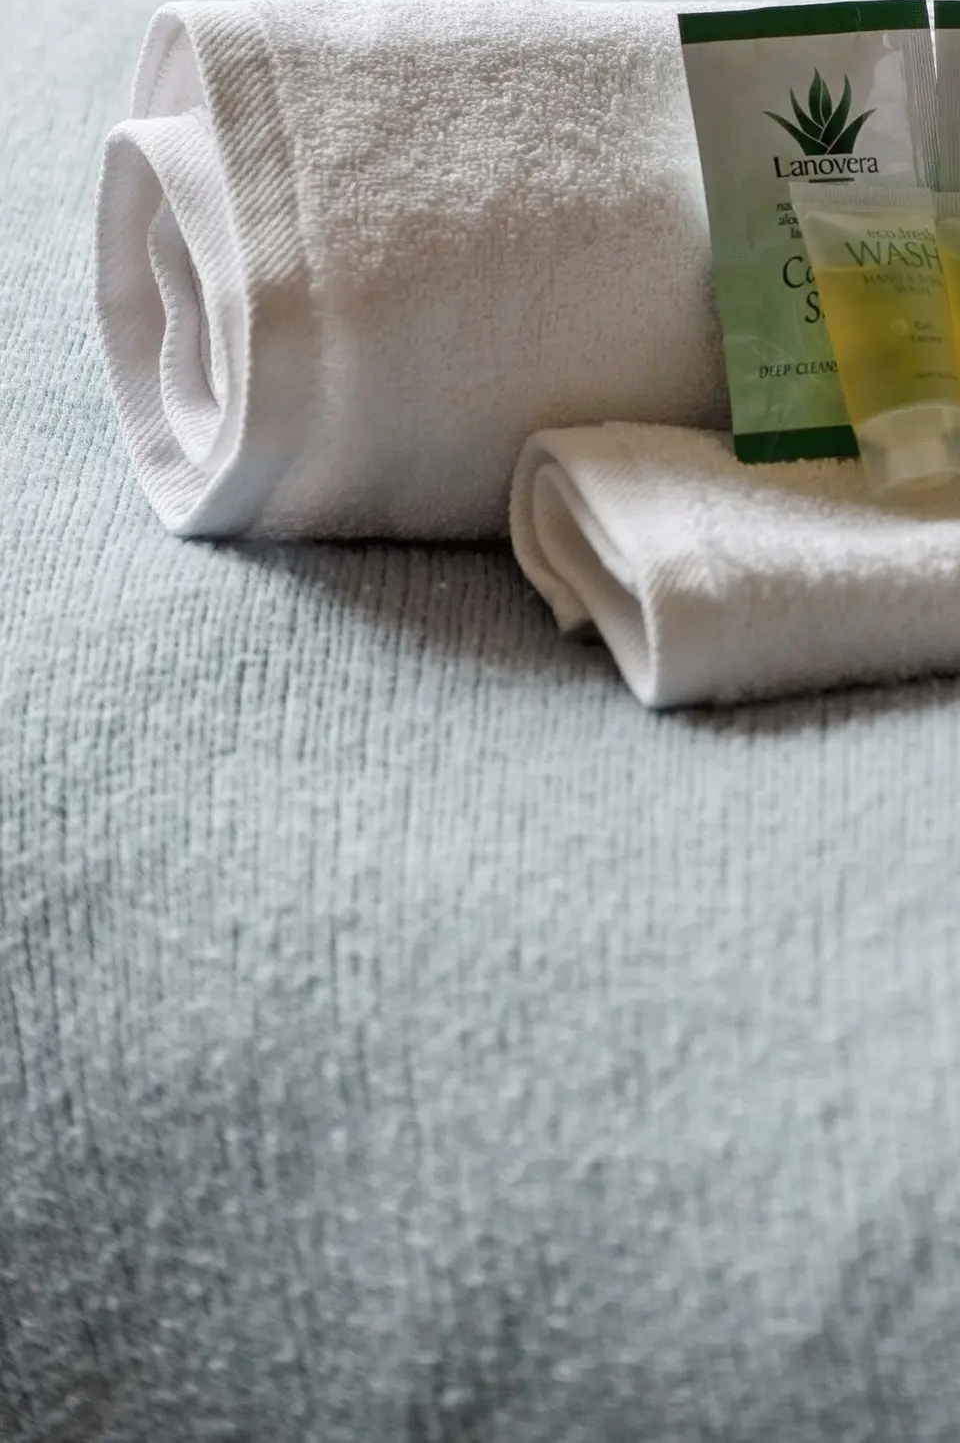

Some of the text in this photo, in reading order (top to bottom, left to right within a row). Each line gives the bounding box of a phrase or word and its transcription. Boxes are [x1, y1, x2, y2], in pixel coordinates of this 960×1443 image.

[773, 156, 880, 178] Lanovera
[844, 241, 945, 275] WASH
[758, 363, 791, 379] DEEP
